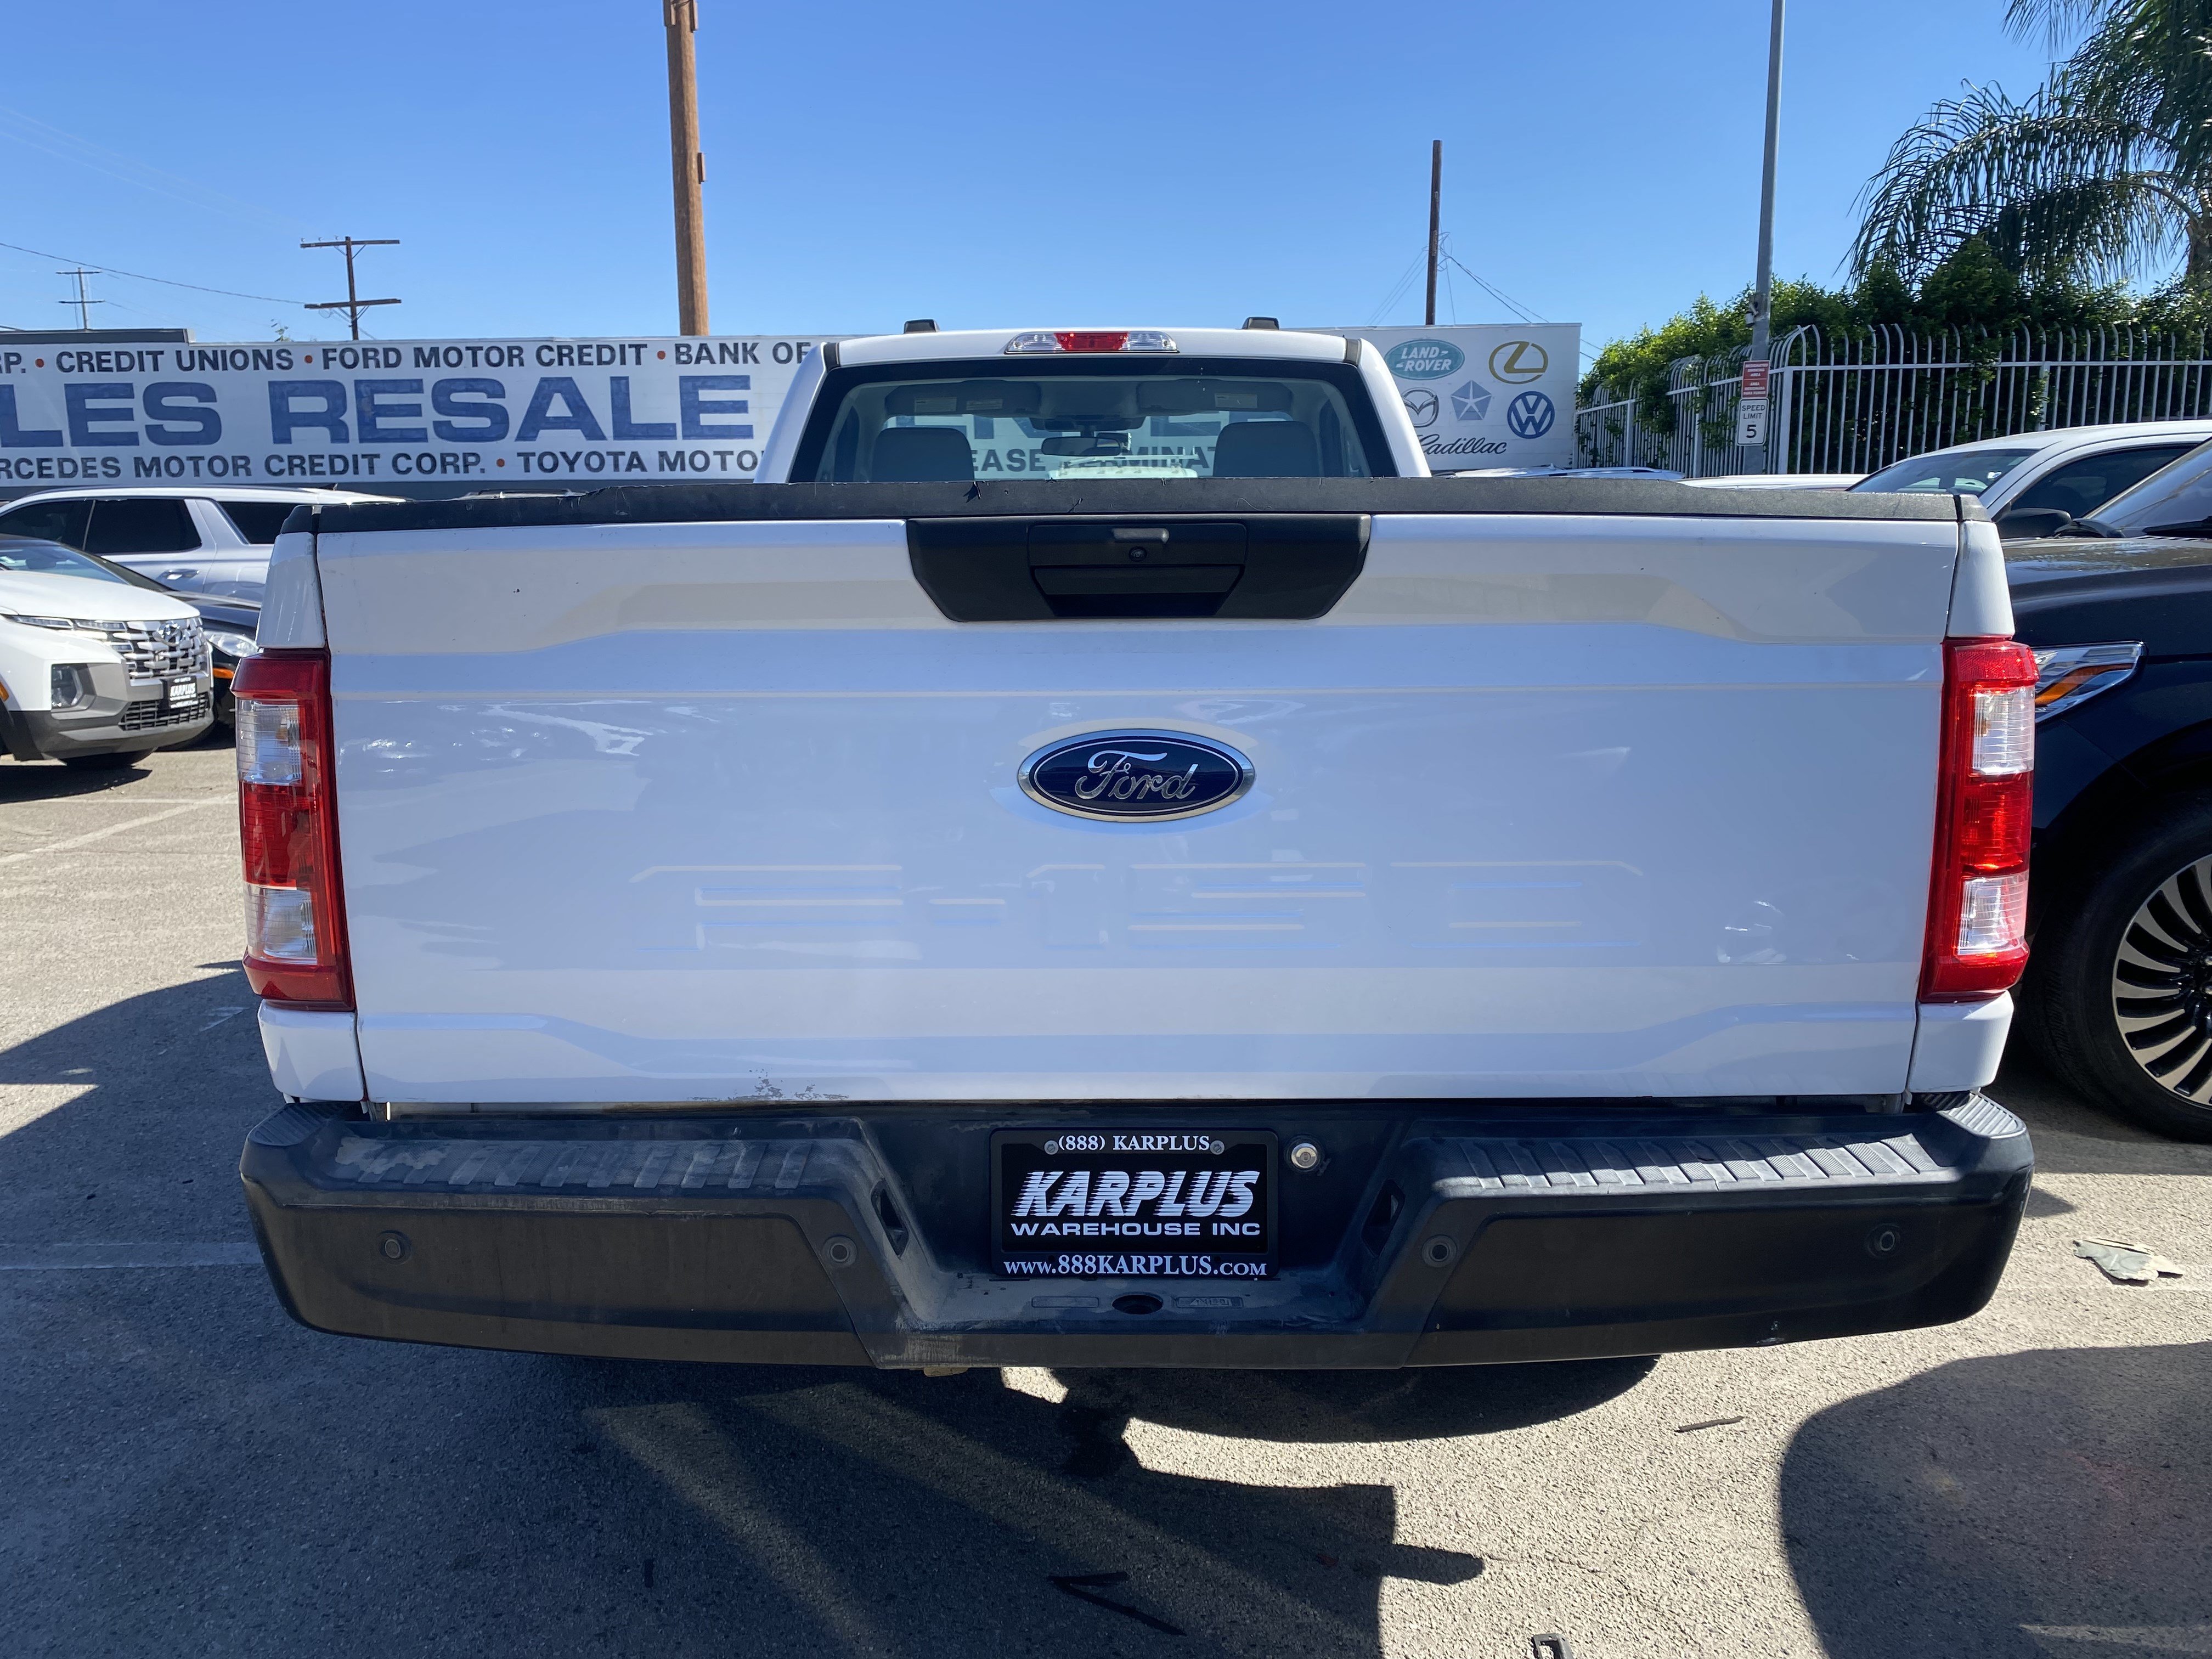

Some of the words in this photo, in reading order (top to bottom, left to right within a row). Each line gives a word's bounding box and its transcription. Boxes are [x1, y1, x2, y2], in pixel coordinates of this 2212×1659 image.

[0, 352, 26, 374] P.
[56, 350, 164, 373] CREDIT
[176, 348, 294, 371] UNIONS
[322, 347, 402, 369] FORD
[414, 346, 524, 368] MOTOR
[535, 344, 647, 366] CREDIT
[675, 342, 760, 364] BANK
[772, 342, 811, 364] OF
[0, 382, 222, 447] LES
[268, 375, 754, 444] RESALE
[1418, 433, 1507, 455] Cadillac
[1746, 425, 1757, 438] 5
[133, 455, 252, 479] MOTOR
[264, 453, 381, 476] CREDIT
[391, 452, 486, 476] CORP.
[517, 451, 648, 473] TOYOTA
[658, 450, 765, 472] MOTO
[1075, 749, 1199, 799] Ford
[1058, 1136, 1105, 1151] (888)
[1113, 1135, 1210, 1150] KARPLUS
[1010, 1170, 1261, 1217] KARPLUS
[1011, 1223, 1200, 1235] WAREHOUSE
[1212, 1223, 1261, 1235] INC
